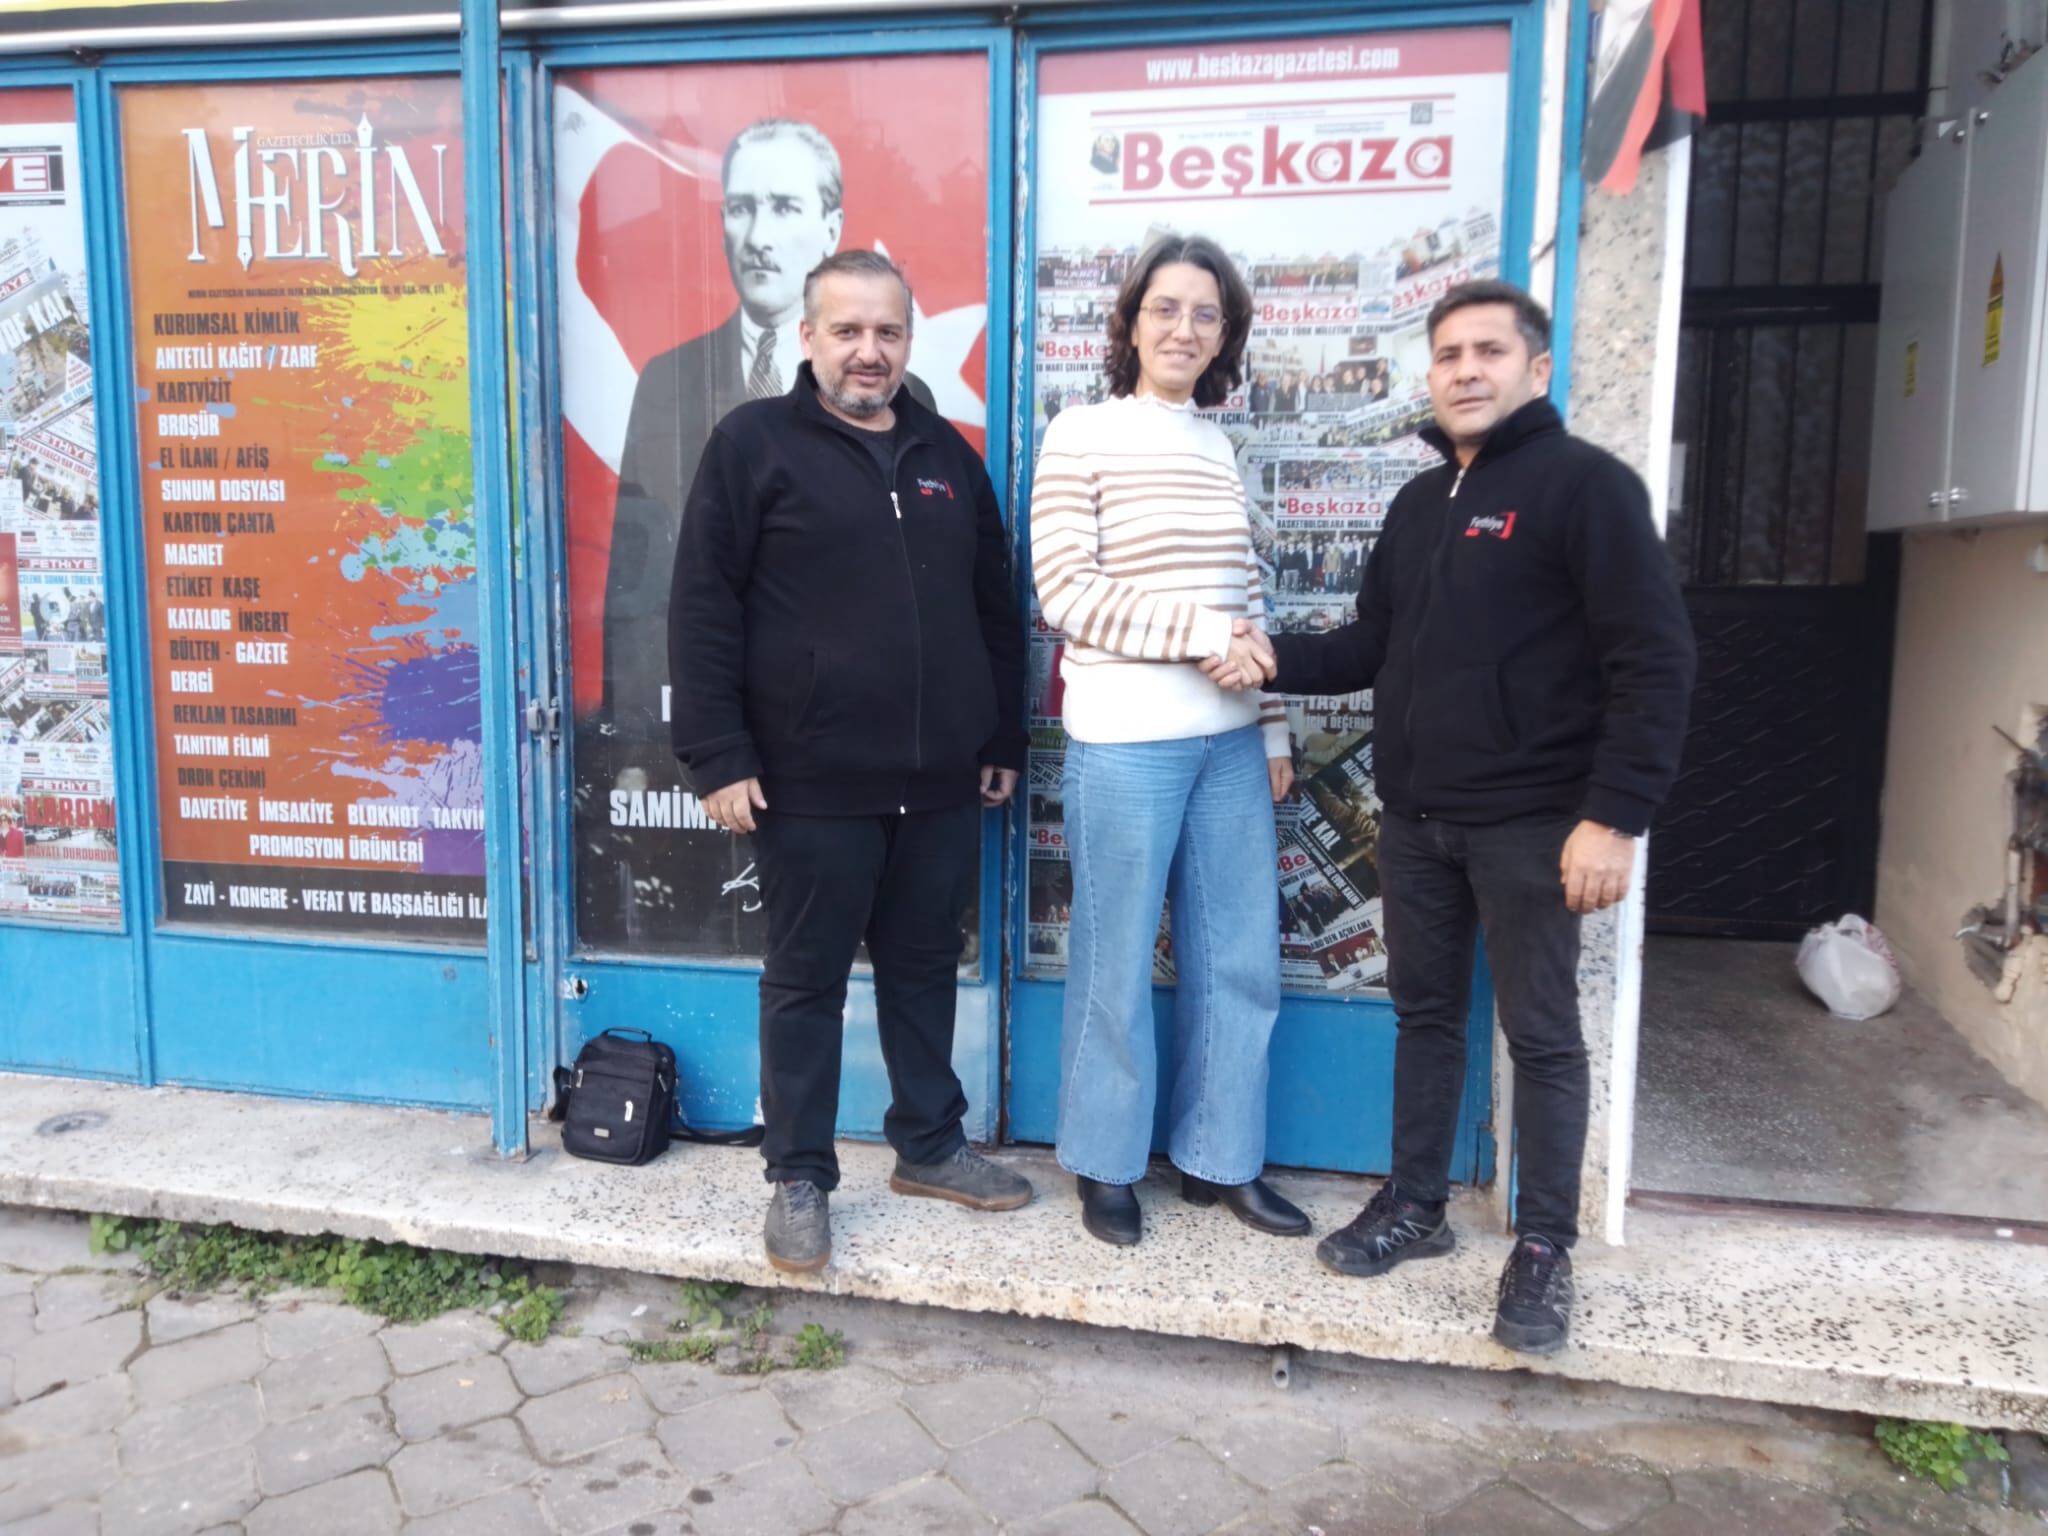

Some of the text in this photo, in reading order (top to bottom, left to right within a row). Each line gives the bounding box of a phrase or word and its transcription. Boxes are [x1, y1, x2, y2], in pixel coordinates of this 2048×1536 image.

[1123, 125, 1453, 197] Beşkaza
[154, 307, 299, 335] KURUMSAL KİMLİK
[1262, 303, 1359, 322] Beşkaza
[156, 342, 213, 369] ANTETLİ
[218, 342, 263, 368] KAĞIT
[280, 345, 317, 368] ZARF
[157, 379, 231, 403] KARTVİZİT
[158, 410, 219, 439] BROŞÜR
[160, 447, 175, 469] EL
[179, 443, 218, 468] İLANI
[236, 444, 269, 471] AFİŞ
[161, 479, 285, 502] SUNUM DOSYASI
[1287, 497, 1381, 516] Beşkaza
[164, 511, 275, 536] KARTON ÇANTA
[165, 543, 223, 566] MAGNET
[166, 575, 260, 600] ETİKET KAŞE
[168, 606, 289, 632] KATALOG İNSERT
[170, 636, 220, 660] BÜLTEN
[235, 642, 288, 664] GAZETE
[171, 667, 213, 693] DERGİ
[174, 704, 296, 726] REKLAM TASARIMI
[174, 733, 270, 757] TANITIM FİLMİ
[177, 766, 265, 790] DRON ÇEKİMİ
[180, 795, 248, 821] DAVETİYE
[259, 796, 334, 824] İMSAKİYE
[348, 803, 420, 829] BLOKNOT
[610, 785, 730, 830] SAMİM
[249, 833, 424, 863] PROMOSYON ÜRÜNLERİ
[184, 881, 215, 905] ZAYİ
[229, 887, 288, 909] KONGRE
[302, 890, 344, 912] VEFAT
[349, 891, 366, 913] VE
[371, 891, 464, 919] BAŞSAĞLIĞI
